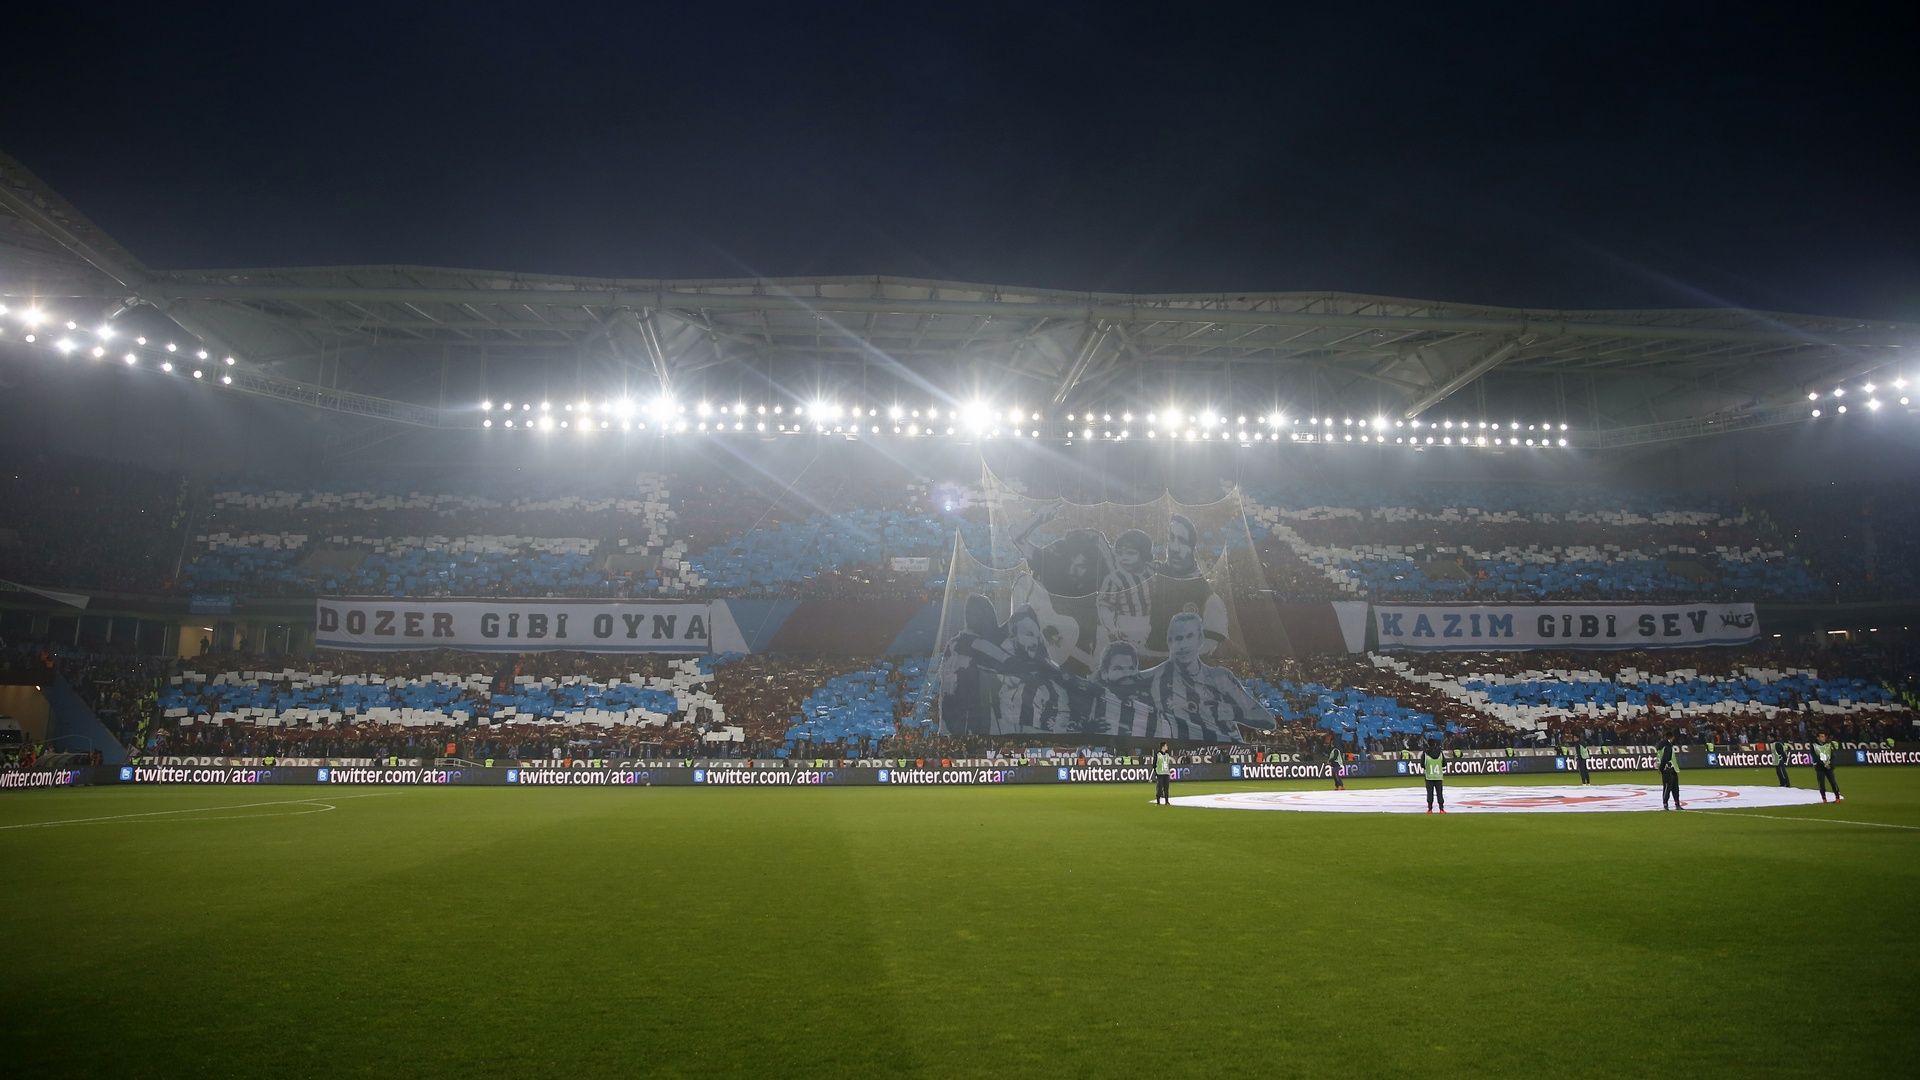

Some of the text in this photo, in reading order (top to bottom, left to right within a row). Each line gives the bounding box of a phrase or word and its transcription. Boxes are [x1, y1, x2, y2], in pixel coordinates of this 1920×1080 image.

[318, 606, 455, 638] DOZER
[593, 613, 708, 640] OYNA
[1381, 612, 1514, 638] KAZIM
[1638, 610, 1708, 637] SEV
[1430, 764, 1440, 775] 14
